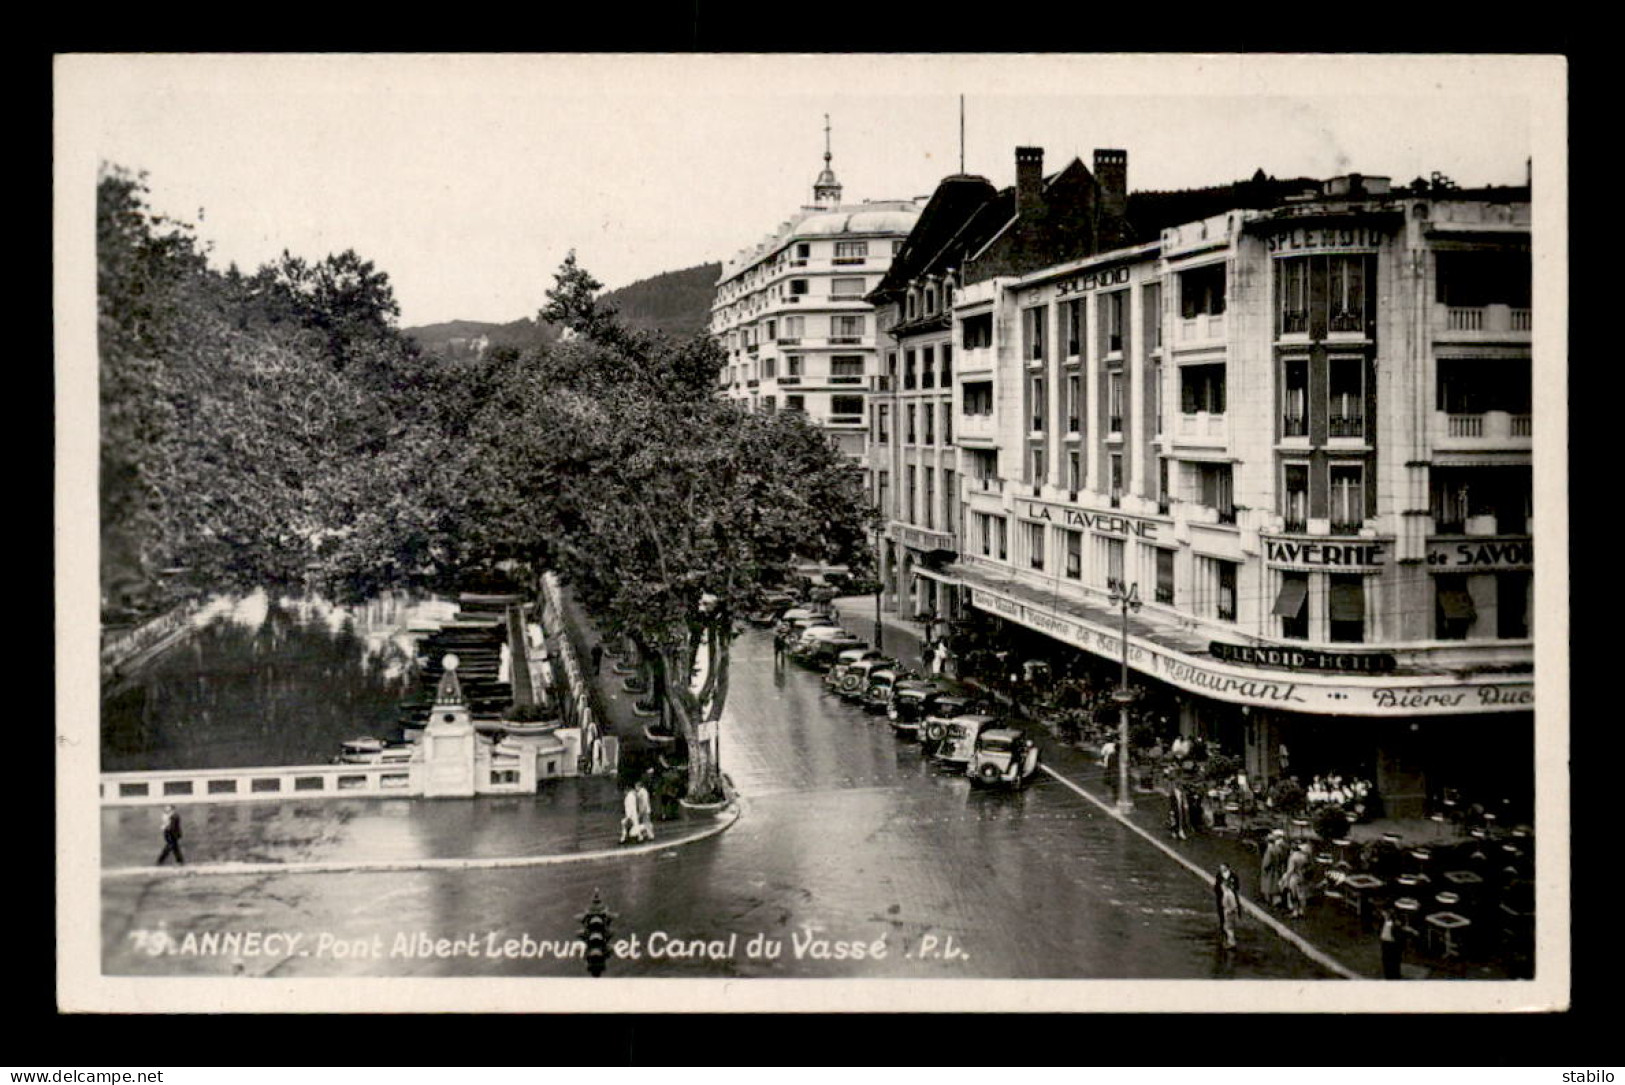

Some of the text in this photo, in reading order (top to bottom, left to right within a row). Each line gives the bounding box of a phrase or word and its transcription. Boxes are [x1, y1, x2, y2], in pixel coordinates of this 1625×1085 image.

[1055, 265, 1130, 298] SPLENDID
[1029, 502, 1158, 540] LA TAVERNE
[1265, 541, 1384, 566] TAVERNE
[1427, 542, 1533, 565] de SAVOI
[1163, 656, 1533, 708] Restaurant Bières Duc
